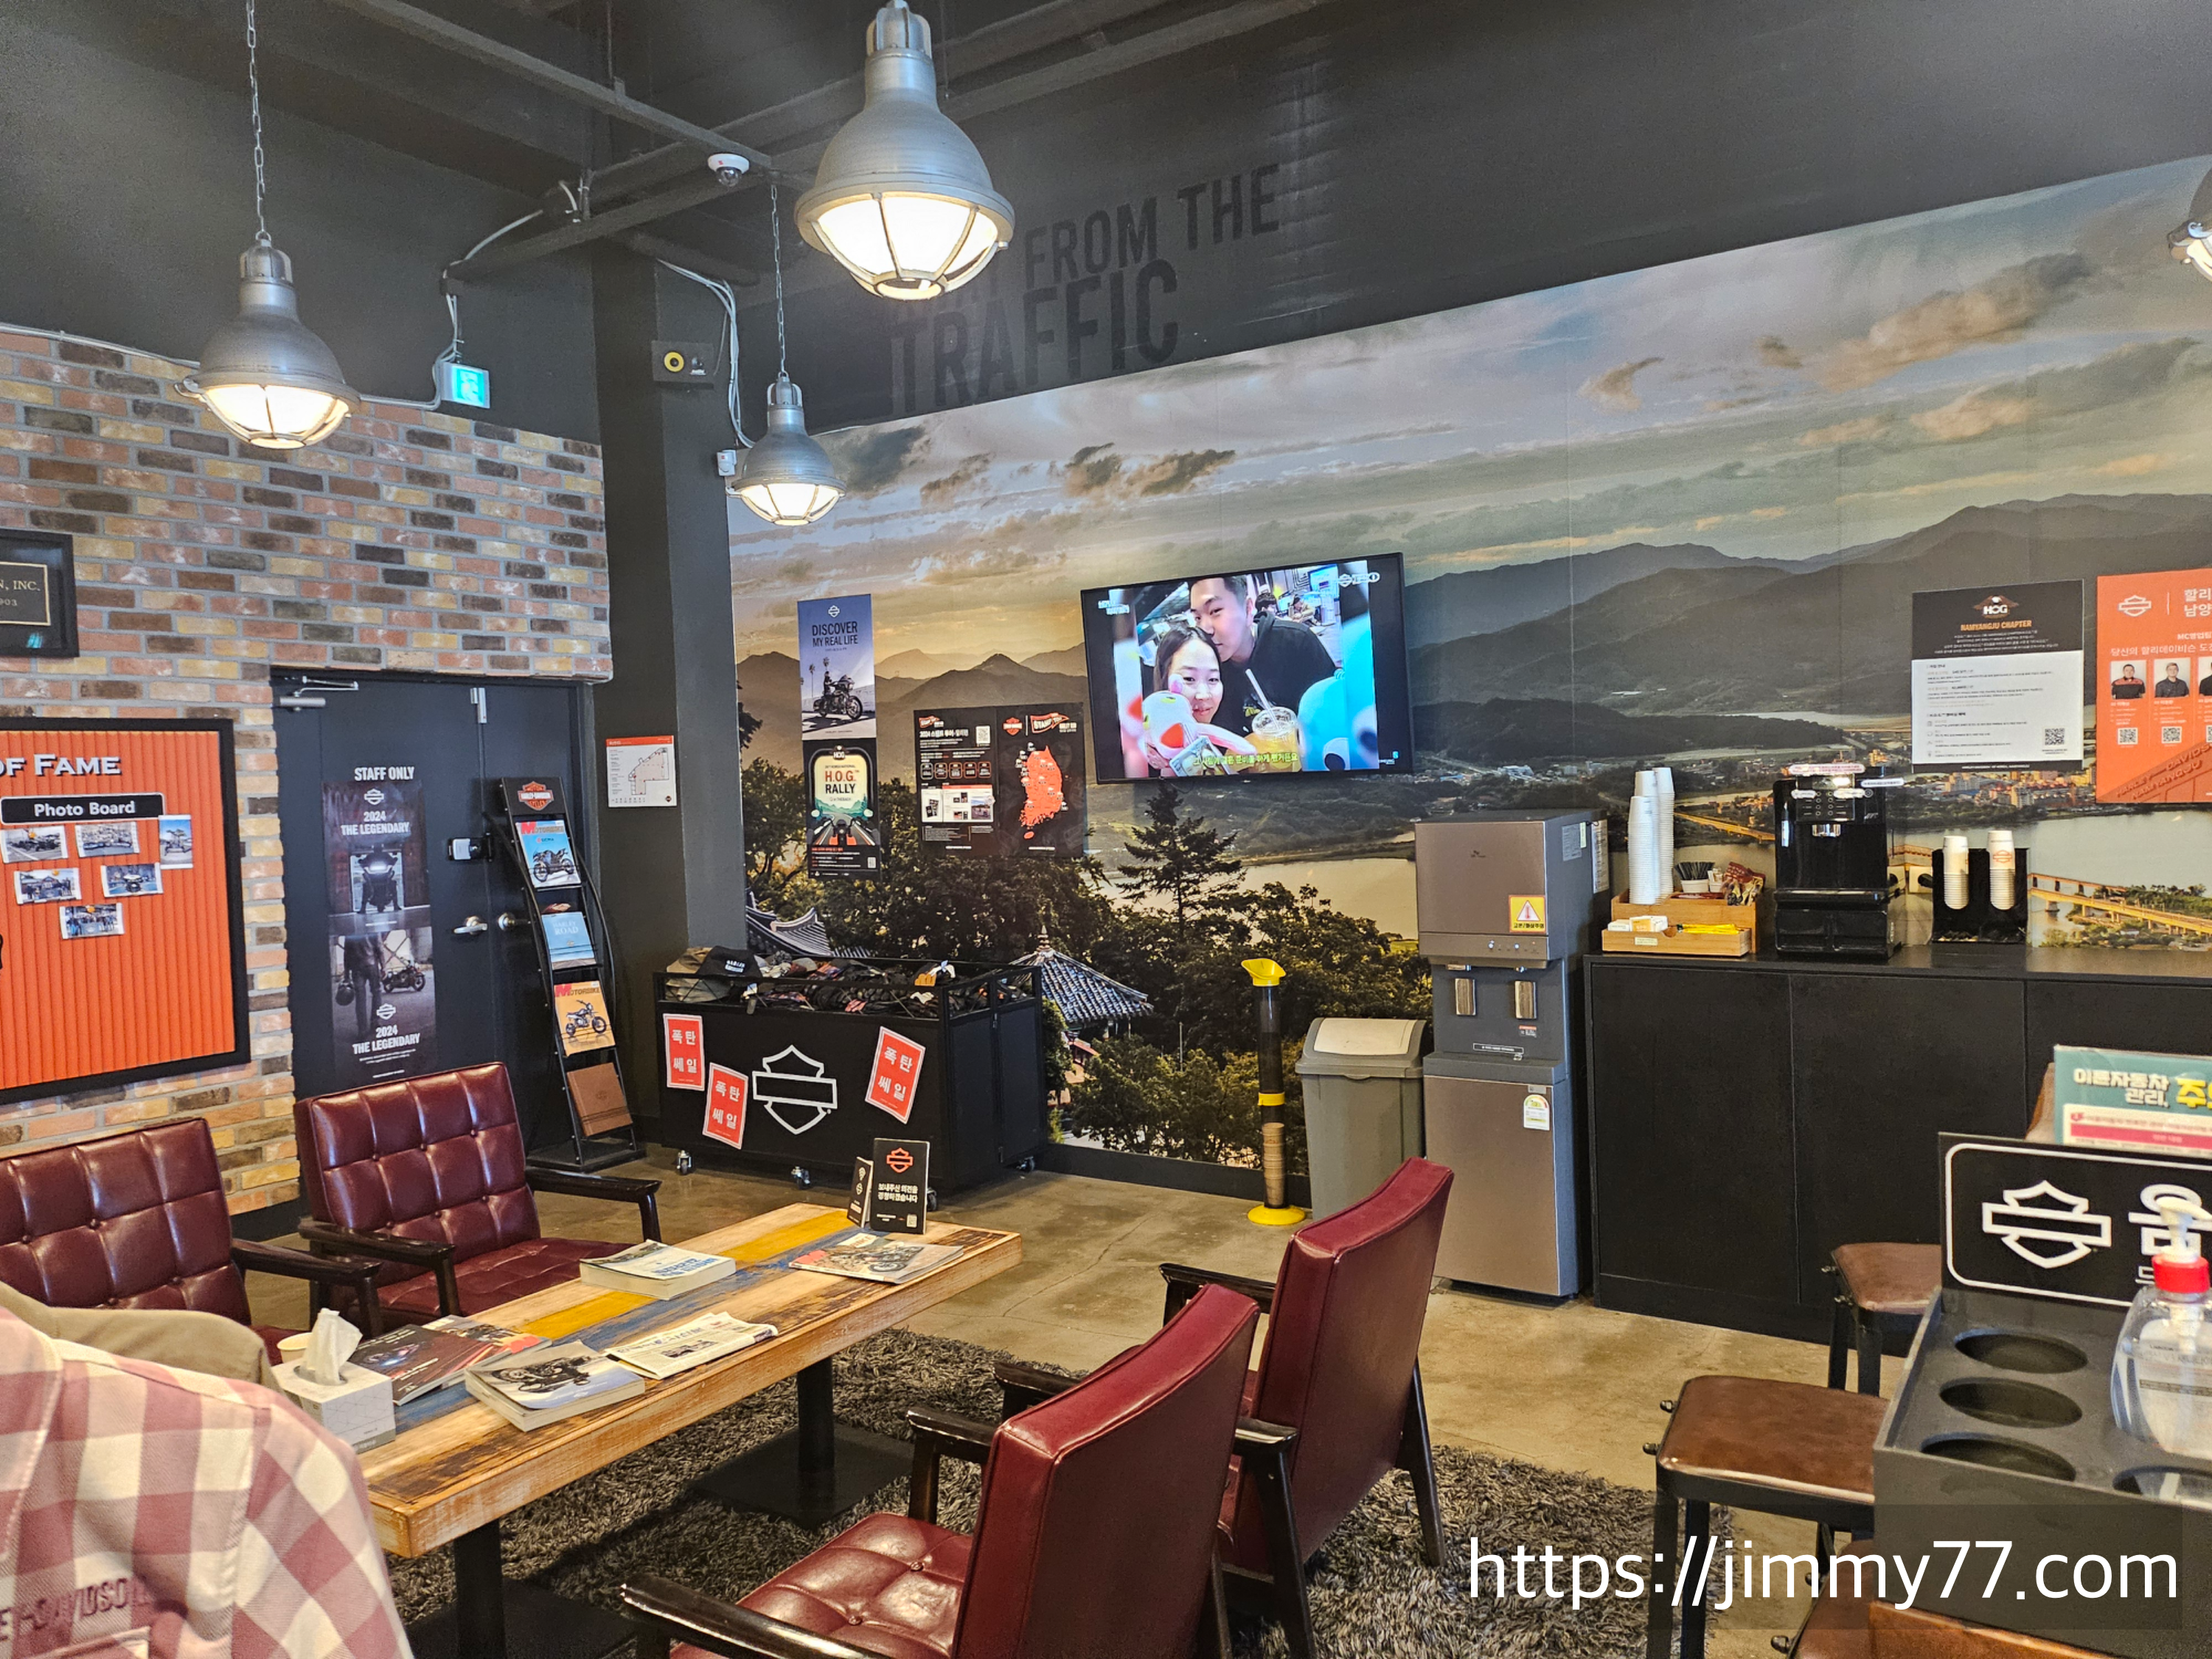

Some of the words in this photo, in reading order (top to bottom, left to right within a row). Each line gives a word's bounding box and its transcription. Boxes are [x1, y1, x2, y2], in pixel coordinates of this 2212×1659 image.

[1025, 197, 1158, 290] FROM
[1178, 162, 1280, 251] THE
[890, 258, 1179, 415] TRAFFIC
[13, 580, 41, 591] INC.
[1983, 605, 2008, 615] HOG
[812, 621, 858, 636] DISCOVER
[2001, 619, 2032, 630] CHAPTER
[813, 636, 824, 647] MY
[824, 636, 842, 647] REAL
[844, 634, 858, 645] LIFE
[2110, 647, 2138, 657] 당신의
[2141, 644, 2197, 655] 할리데이비슨
[34, 754, 122, 775] FAME
[354, 767, 386, 781] STAFF
[388, 766, 414, 780] ONLY
[825, 783, 856, 794] RALLY
[34, 803, 83, 817] Photo
[89, 801, 136, 815] Board
[364, 810, 386, 822] 2024
[341, 824, 358, 836] THE
[360, 821, 410, 835] LEGENDARY
[554, 926, 579, 936] ROAD
[554, 983, 600, 998] MOTORBIKE
[375, 1024, 398, 1037] 2024
[672, 1029, 696, 1046] 폭탄
[352, 1042, 370, 1054] THE
[372, 1033, 421, 1051] LEGENDARY
[673, 1057, 697, 1074] 쎄일
[884, 1046, 913, 1073] 폭탄
[2073, 1068, 2170, 1091] 이륜자동차
[715, 1080, 740, 1102] 폭탄
[877, 1076, 907, 1102] 쎄일
[2125, 1088, 2170, 1108] 관리,
[2176, 1077, 2212, 1110] 주
[712, 1107, 737, 1130] 쎄일
[877, 1183, 901, 1193] 보내주신
[901, 1184, 919, 1194] 의견을
